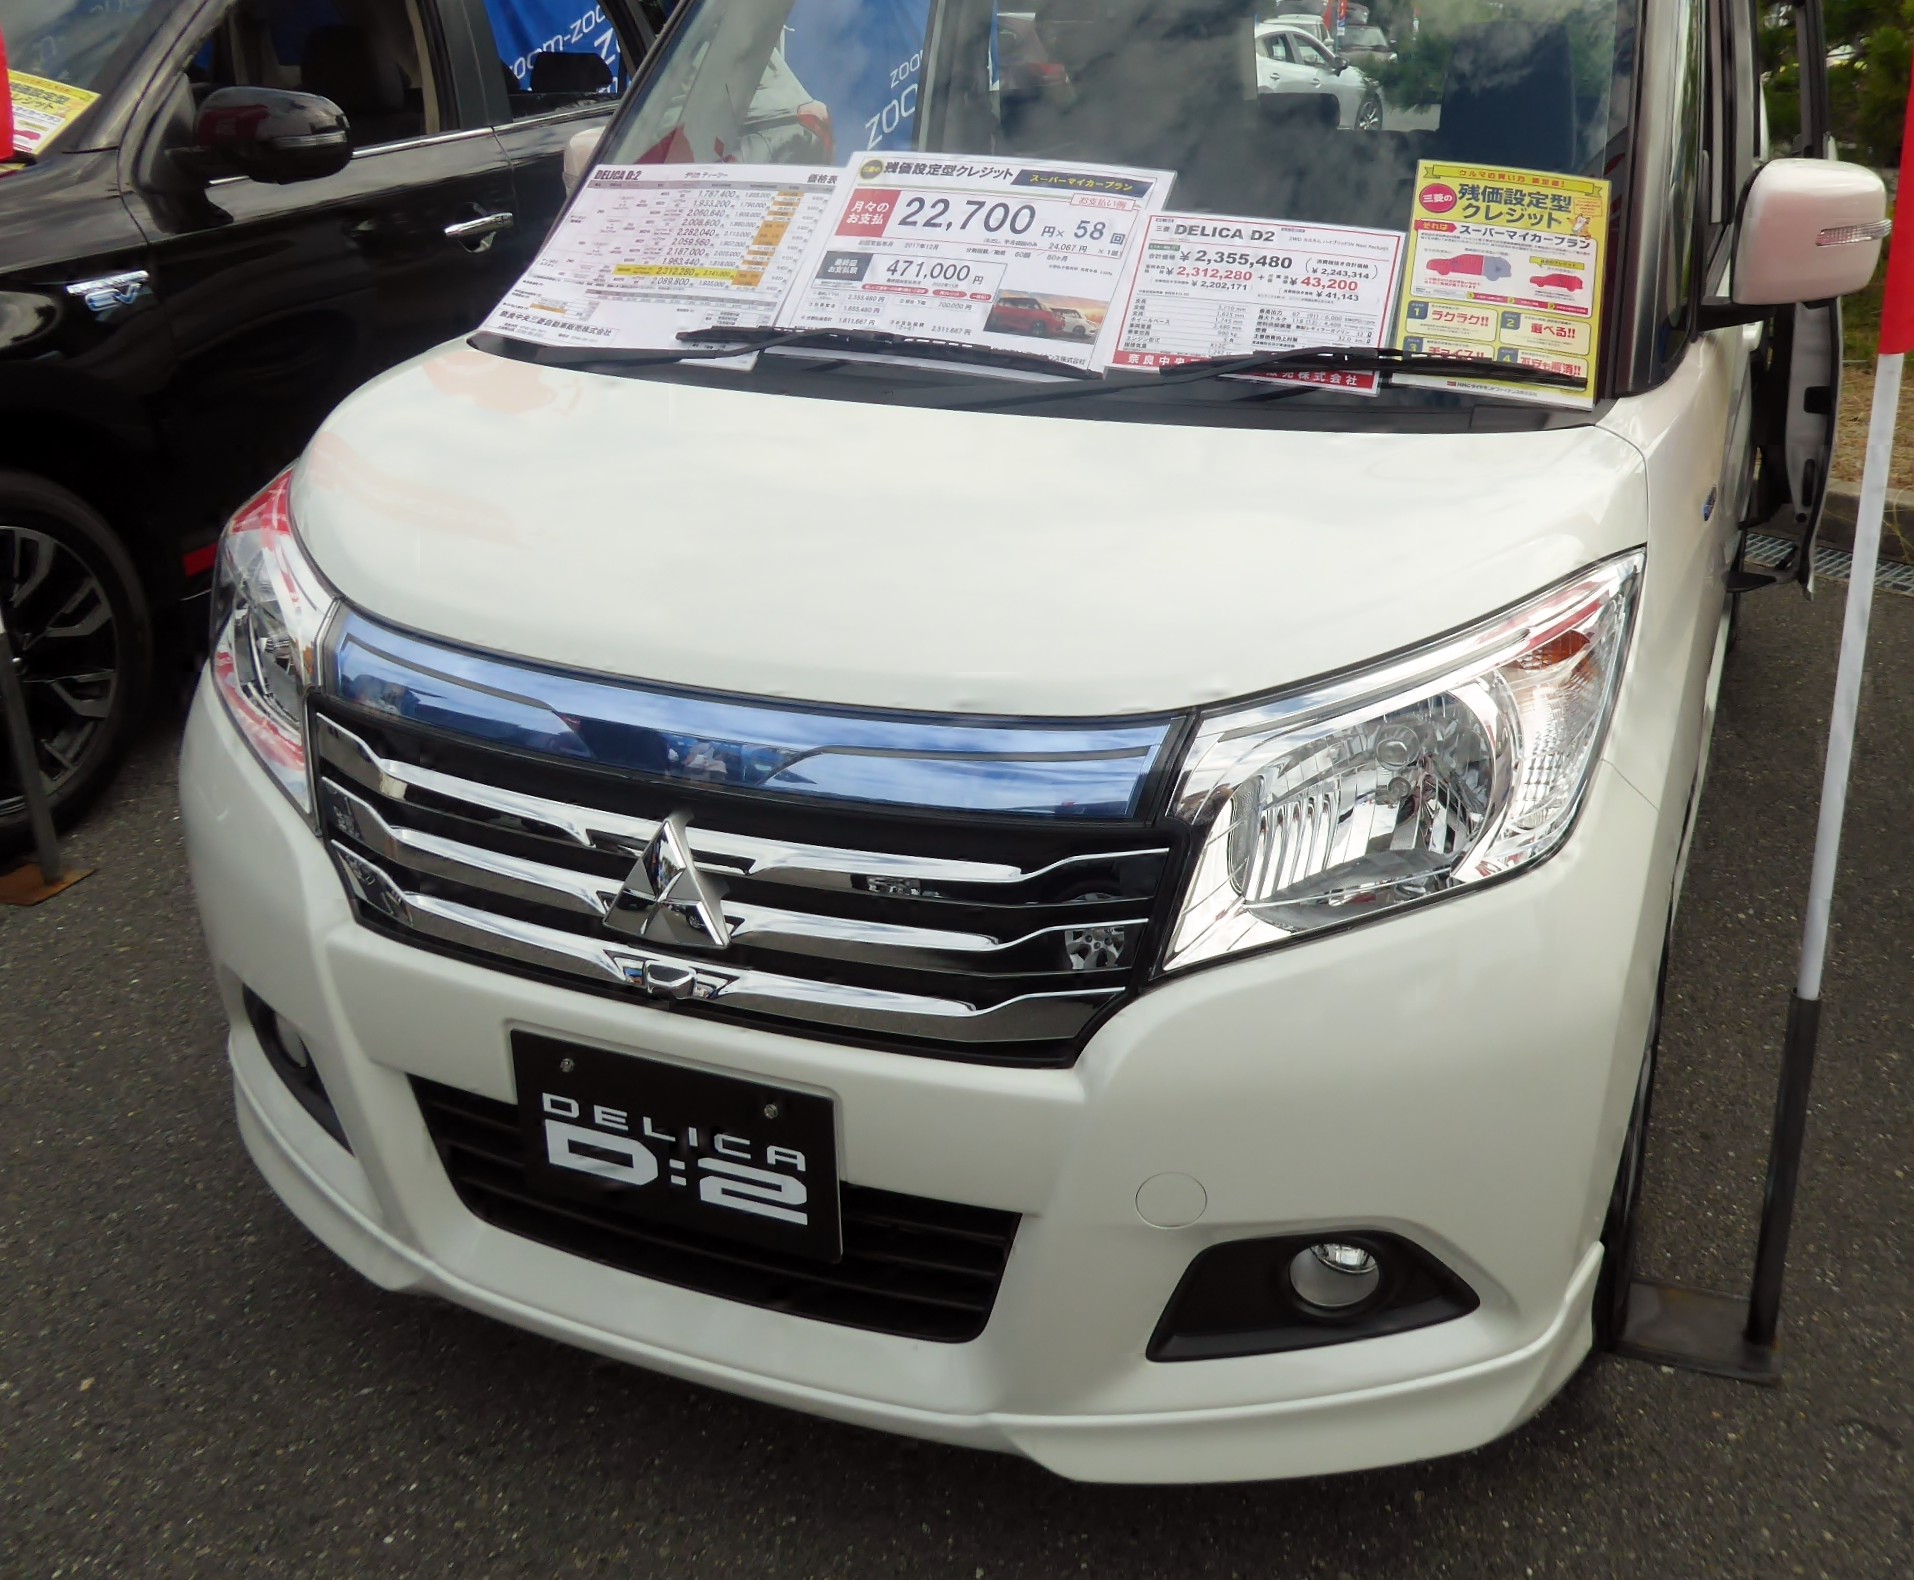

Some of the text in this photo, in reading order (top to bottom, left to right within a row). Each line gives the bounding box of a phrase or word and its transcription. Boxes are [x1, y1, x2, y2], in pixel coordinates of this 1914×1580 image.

[594, 169, 626, 180] DELICA
[807, 173, 838, 184] 価格表
[884, 161, 1133, 191] 残価設定型クレジット スーパーマイカープラン
[1423, 194, 1452, 204] 三菱の
[1458, 183, 1572, 214] 残価設定型
[851, 200, 890, 213] 月々の
[846, 213, 884, 225] お支払
[898, 196, 1036, 235] 22,700
[1074, 219, 1106, 240] 58
[1110, 232, 1126, 245] 回
[1462, 203, 1562, 229] クレジット
[1174, 224, 1244, 240] DELICA
[1250, 229, 1275, 242] D2
[1460, 225, 1591, 250] スーパーマイカープラン
[904, 241, 939, 251] 2017年12月
[1194, 249, 1293, 270] 2,355,480
[887, 259, 971, 281] 471,000
[972, 275, 984, 285] 円
[1176, 266, 1253, 281] 2,312,280
[1321, 268, 1369, 280] 2,243,314
[1200, 280, 1248, 291] 2,202,171
[1301, 276, 1358, 291] 43,200
[1325, 292, 1359, 302] 41,143
[1413, 307, 1420, 316] 1
[1431, 310, 1489, 328] ラクラク!!
[1505, 318, 1515, 328] 2
[1531, 322, 1576, 340] 選べる!!
[542, 1092, 806, 1172] DELICA
[545, 1119, 808, 1225] D:2
